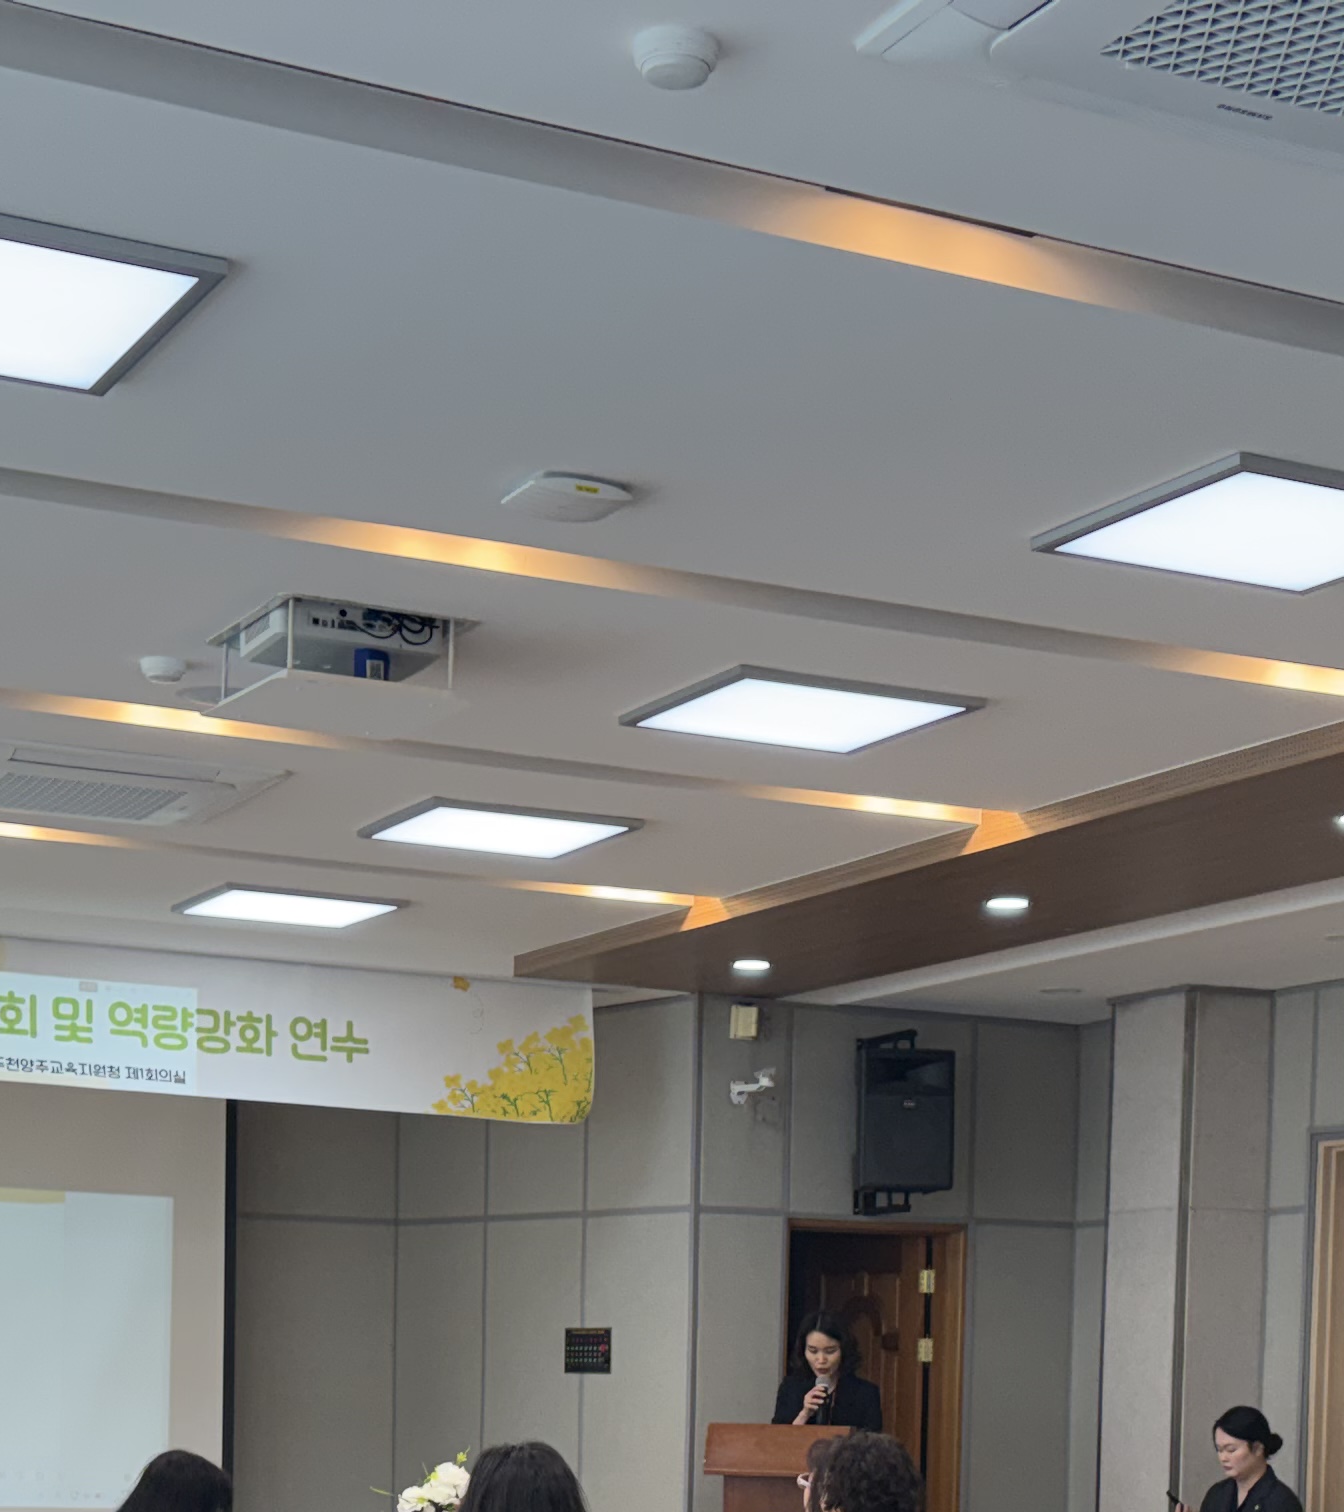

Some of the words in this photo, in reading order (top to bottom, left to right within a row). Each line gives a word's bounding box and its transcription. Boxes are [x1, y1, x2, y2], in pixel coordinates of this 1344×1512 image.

[51, 996, 94, 1044] 및
[108, 1001, 279, 1057] 역량강화
[289, 1016, 370, 1063] 연수
[125, 1066, 187, 1085] 제1회의실
